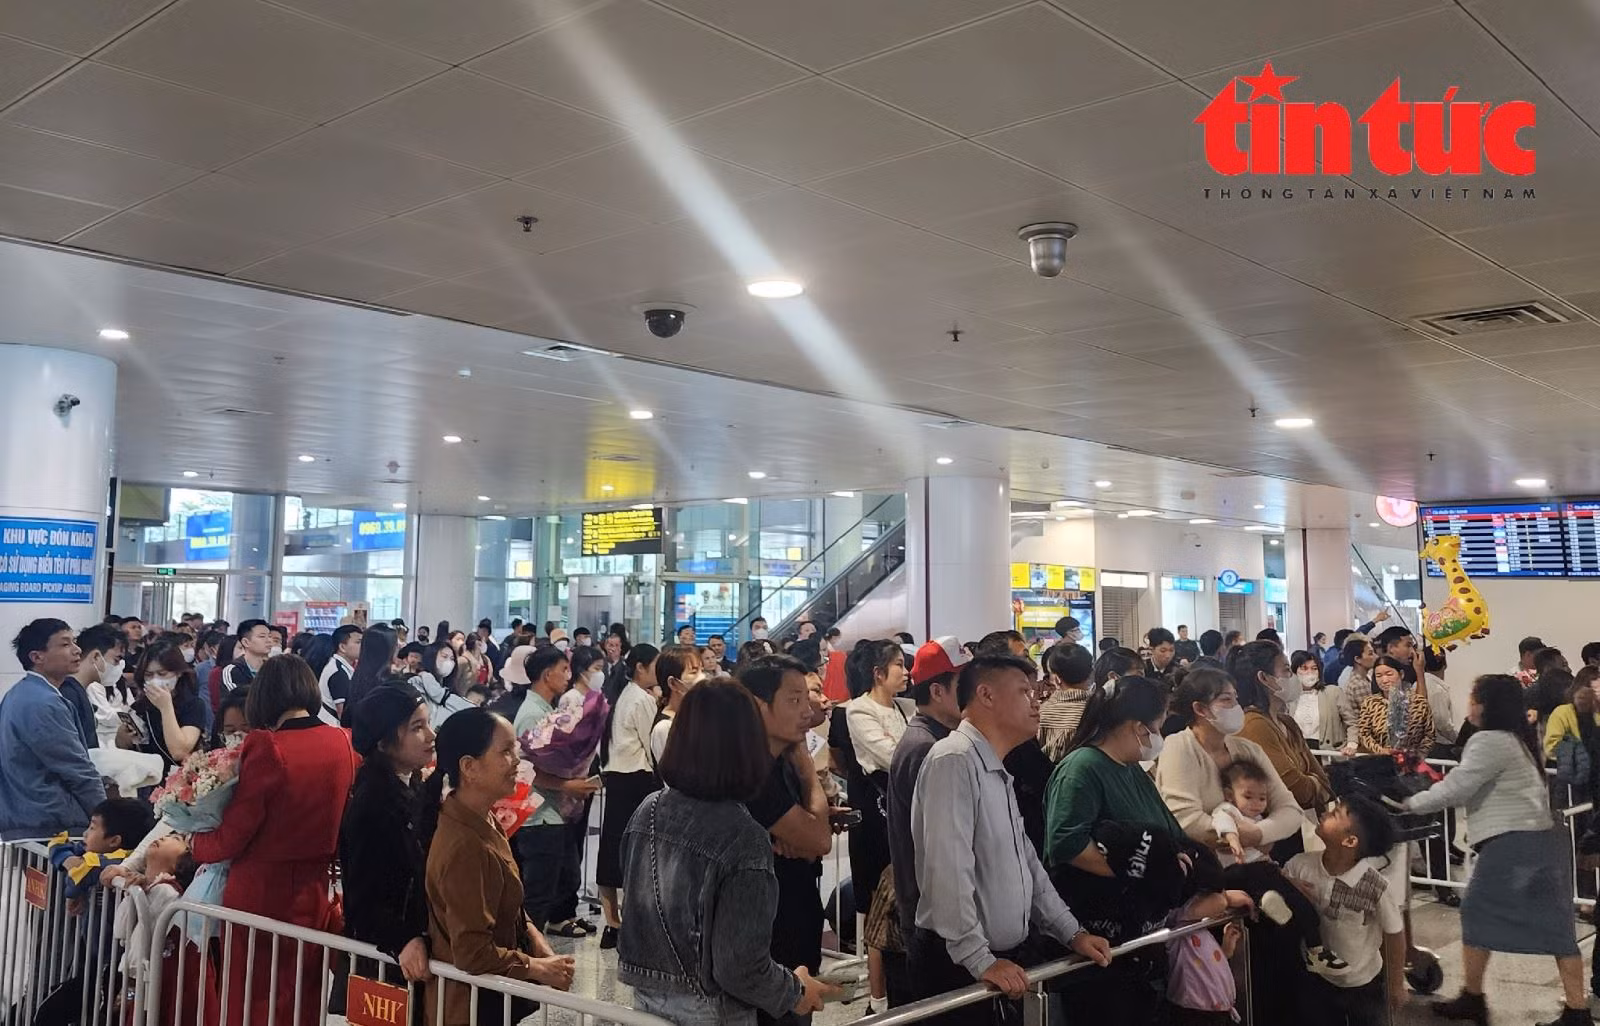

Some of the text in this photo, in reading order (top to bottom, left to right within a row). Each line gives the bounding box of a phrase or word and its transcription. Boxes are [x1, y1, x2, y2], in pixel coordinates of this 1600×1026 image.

[3, 527, 26, 544] KHU
[27, 528, 48, 548] VỰC
[20, 583, 41, 592] BOARD
[42, 583, 63, 593] PICKUP
